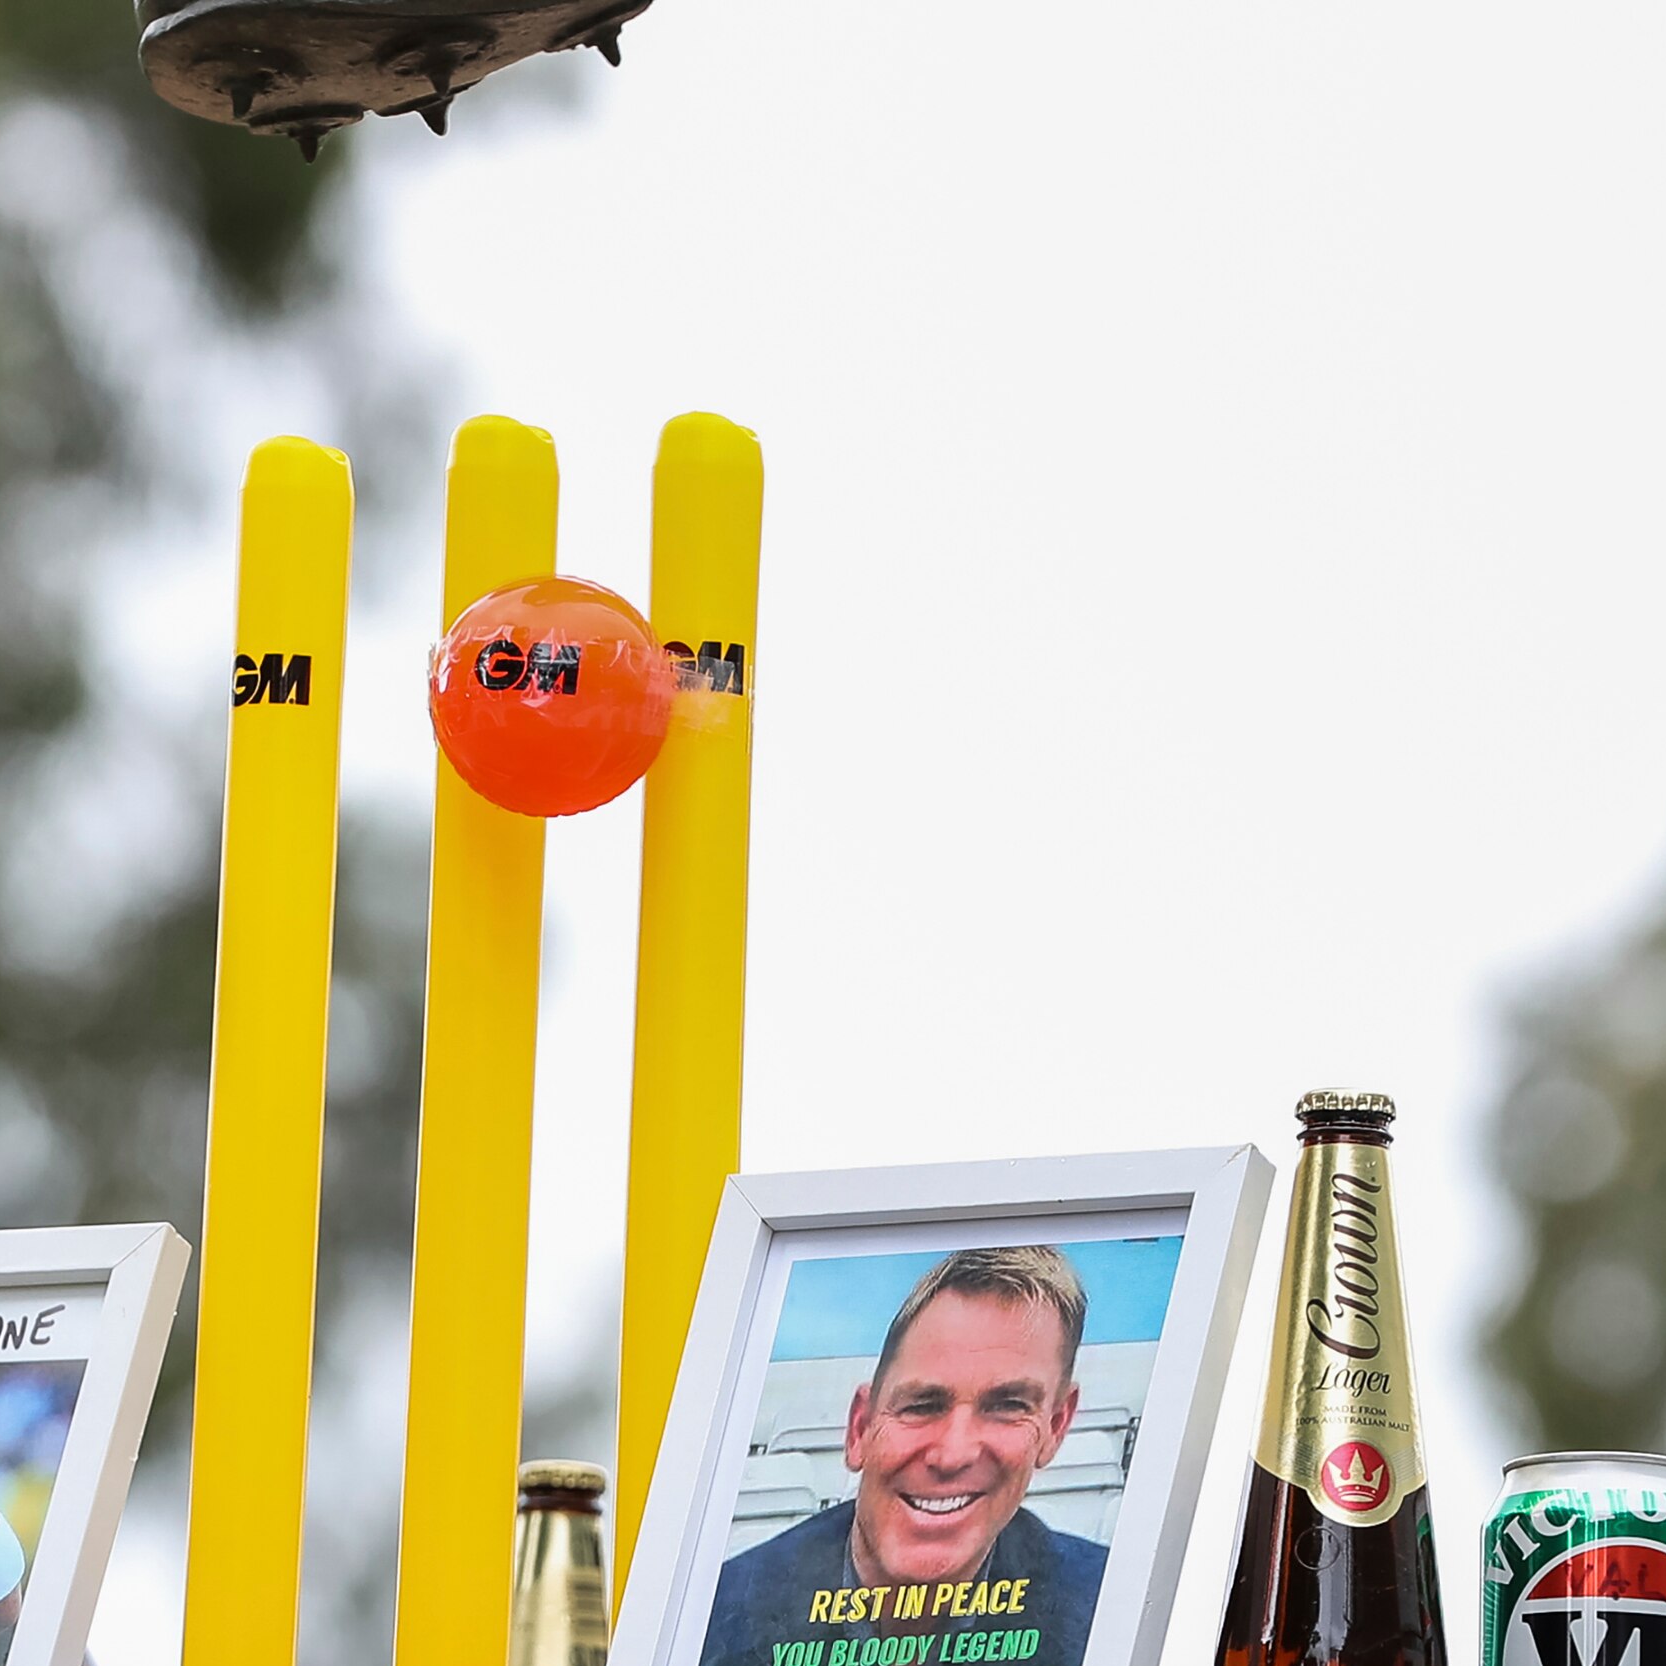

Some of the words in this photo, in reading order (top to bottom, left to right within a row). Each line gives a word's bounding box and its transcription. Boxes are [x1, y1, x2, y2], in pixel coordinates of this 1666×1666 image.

[232, 654, 312, 707] GM
[475, 639, 581, 696] GM
[1306, 1173, 1382, 1360] Crown
[1312, 1362, 1391, 1398] Lager
[1320, 1416, 1386, 1429] AUSTRALIAN
[1388, 1421, 1410, 1433] MALT
[1323, 1405, 1357, 1415] MADE
[1359, 1405, 1387, 1417] FROM
[808, 1587, 890, 1624] REST
[893, 1584, 928, 1620] IN
[931, 1578, 1030, 1617] PEACE
[938, 1628, 1041, 1664] LEGEND
